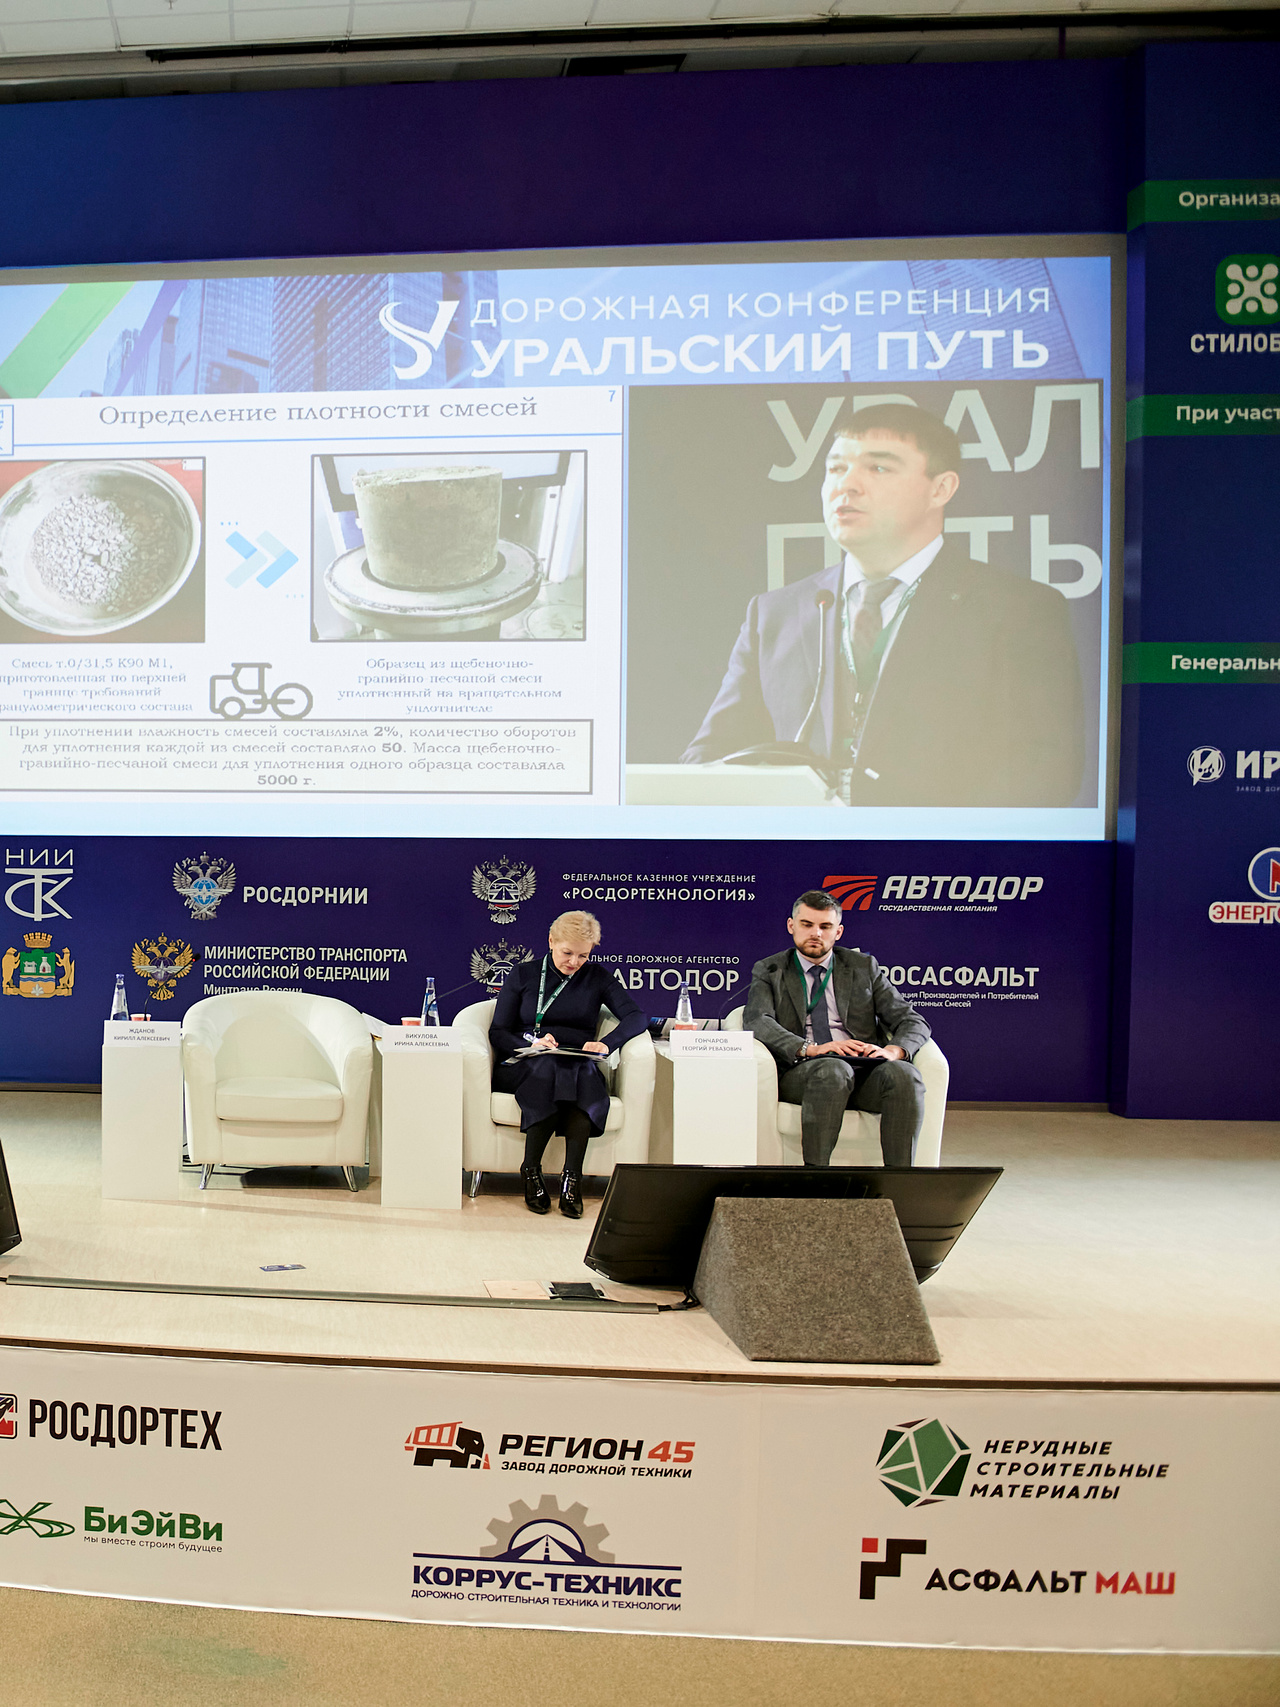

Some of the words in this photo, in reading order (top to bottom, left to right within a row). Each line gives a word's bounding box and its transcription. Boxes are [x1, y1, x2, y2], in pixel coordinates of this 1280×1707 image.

[1178, 191, 1280, 210] Организа
[469, 294, 710, 328] ДОРОЖНАЯ
[727, 287, 1050, 320] КОНФЕРЕНЦИЯ
[469, 324, 852, 379] УРАЛЬСКИЙ
[878, 329, 1050, 371] ПУТЬ
[1190, 333, 1280, 353] СТИЛОБ
[608, 390, 616, 402] 7
[99, 405, 277, 428] Определение
[287, 402, 430, 422] плотности
[440, 396, 538, 419] смесей
[1176, 406, 1219, 424] При
[1224, 407, 1280, 424] участ
[766, 382, 1101, 482] УАЛ
[766, 514, 1103, 599] ПТЬ
[12, 658, 52, 669] Смесь
[118, 658, 144, 668] К90
[366, 658, 426, 670] Образец
[430, 661, 446, 669] из
[450, 658, 534, 670] щебеночно-
[1171, 654, 1280, 674] Генеральн
[110, 674, 127, 683] по
[131, 672, 186, 684] верхней
[500, 674, 542, 684] смеси
[23, 688, 78, 699] границе
[82, 687, 161, 699] требований
[337, 688, 432, 701] уплотненный
[436, 690, 454, 698] на
[458, 690, 563, 700] вращательном
[140, 703, 193, 712] состава
[405, 704, 494, 715] уплотнителе
[8, 726, 40, 739] При
[44, 727, 133, 739] уплотнении
[138, 728, 220, 738] влажность
[224, 725, 278, 738] смесей
[282, 727, 370, 738] составляла
[373, 726, 404, 740] 2%,
[408, 726, 499, 738] количество
[503, 726, 577, 740] оборотов
[22, 743, 48, 755] для
[52, 743, 141, 755] уплотнения
[146, 741, 205, 755] каждой
[210, 744, 228, 753] из
[232, 741, 286, 753] смесей
[290, 742, 377, 754] составляло
[381, 742, 407, 754] 50.
[412, 742, 462, 754] Масса
[466, 742, 561, 755] щебеночно-
[19, 758, 168, 770] гравийно-песчаной
[172, 760, 218, 770] смеси
[222, 759, 250, 770] для
[254, 759, 345, 772] уплотнения
[350, 760, 403, 771] одного
[408, 758, 473, 772] образца
[477, 759, 566, 770] составляла
[1236, 750, 1280, 779] ИР
[257, 774, 298, 786] 5000
[302, 776, 316, 786] г.
[6, 848, 74, 866] НИИ
[562, 872, 633, 883] ФЕДЕРАЛЬНОЕ
[636, 873, 689, 883] КАЗЕННОЕ
[692, 874, 756, 884] УЧРЕЖДЕНИЕ
[242, 886, 369, 908] РОСДОРНИИ
[562, 886, 756, 902] «РОСДОРТЕХНОЛОГИЯ»
[881, 876, 1045, 902] АВТОДОР
[878, 904, 952, 912] ГОСУДАРСТВЕННАЯ
[954, 904, 998, 913] КОМПАНИЯ
[1211, 904, 1280, 921] ЭНЕРГ
[204, 946, 316, 961] МИНИСТЕРСТВО
[318, 947, 408, 963] ТРАНСПОРТА
[626, 954, 682, 964] ДОРОЖНОЕ
[686, 955, 740, 964] АГЕНТСТВО
[204, 962, 300, 980] РОССИЙСКОЙ
[303, 965, 390, 983] ФЕДЕРАЦИИ
[919, 992, 980, 1000] Производителей
[988, 992, 1039, 1001] Потребителей
[944, 1000, 972, 1008] Смесей
[29, 1398, 223, 1451] РОСДОРТЕХ
[498, 1434, 645, 1462] РЕГИОН
[647, 1440, 696, 1464] 45
[983, 1439, 1113, 1457] НЕРУДНЫЕ
[501, 1460, 546, 1474] ЗАВОД
[548, 1463, 626, 1478] ДОРОЖНОЙ
[630, 1466, 692, 1478] ТЕХНИКИ
[976, 1462, 1170, 1478] СТРОИТЕЛЬНЫЕ
[970, 1483, 1121, 1500] МАТЕРИАЛЫ
[84, 1506, 223, 1542] БиЭйВи
[84, 1536, 98, 1544] мы
[101, 1537, 136, 1547] вместе
[138, 1540, 176, 1550] строим
[178, 1541, 223, 1553] будущее
[412, 1565, 682, 1598] КОРРУС-ТЕХНИКС
[924, 1568, 1088, 1594] АСФАЛЬТ
[1095, 1570, 1176, 1596] МАШ
[411, 1589, 465, 1602] ДОРОЖНО
[468, 1592, 550, 1606] СТРОИТЕЛЬНАЯ
[552, 1597, 600, 1608] ТЕХНИКА
[602, 1600, 610, 1608] И
[612, 1600, 682, 1612] ТЕХНОЛОГИИ
